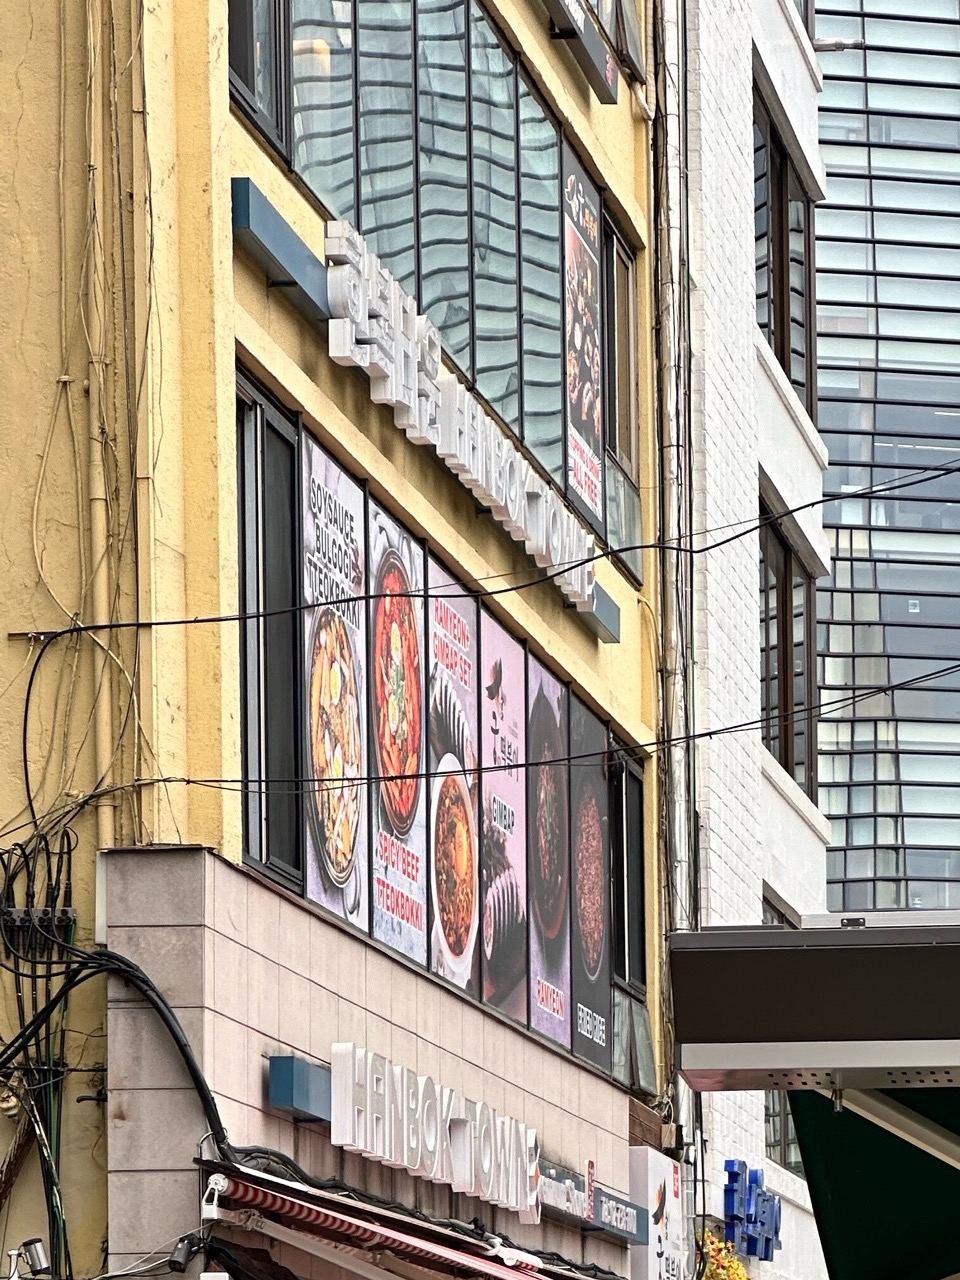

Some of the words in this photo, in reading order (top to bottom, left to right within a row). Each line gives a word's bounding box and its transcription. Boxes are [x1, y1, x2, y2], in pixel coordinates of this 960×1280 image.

[437, 374, 529, 541] HANBOK
[315, 519, 355, 584] BULGOGI
[432, 631, 459, 678] GIMBAP
[458, 656, 473, 690] SET
[492, 795, 515, 835] GIMBAP
[379, 835, 401, 870] SPICY
[401, 849, 420, 881] BEEF
[375, 876, 424, 931] TTEOKBOKKI
[331, 1042, 455, 1184] HANBOK
[449, 1097, 530, 1211] TOWN
